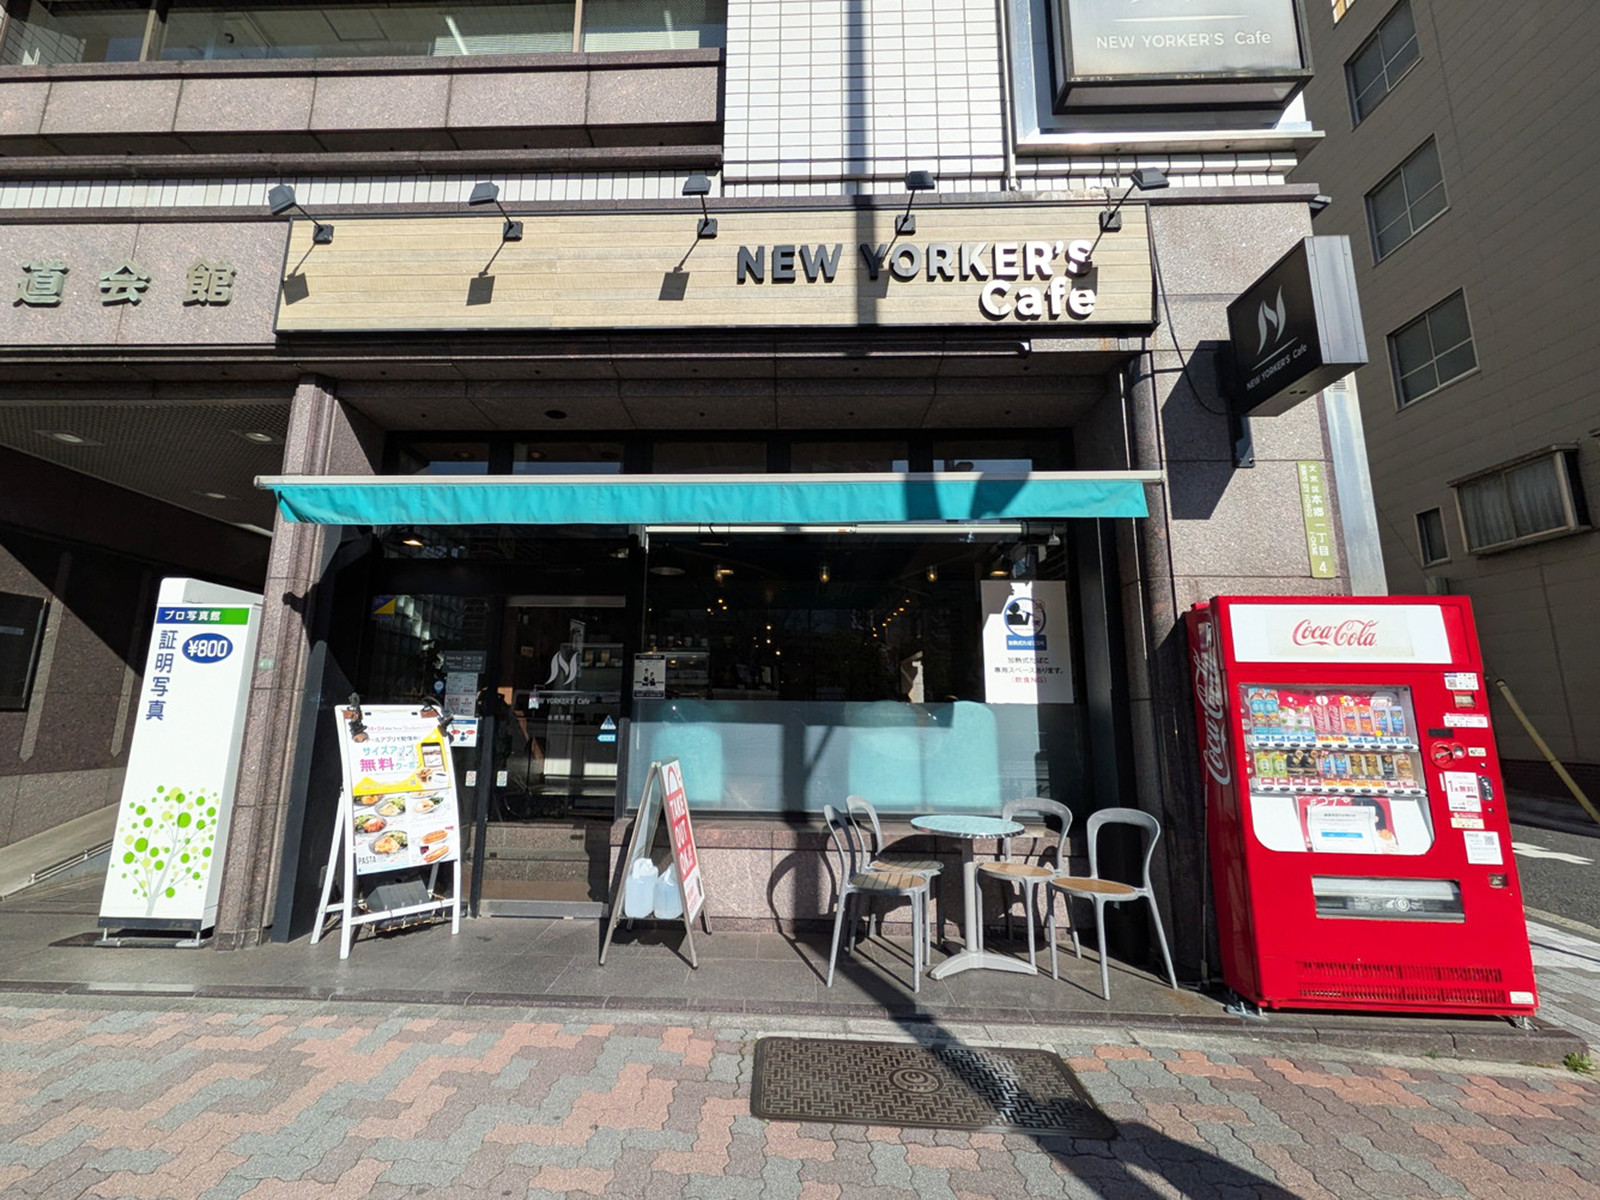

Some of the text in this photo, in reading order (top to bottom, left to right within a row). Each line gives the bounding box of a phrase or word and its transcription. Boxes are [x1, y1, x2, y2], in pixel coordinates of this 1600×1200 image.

[1096, 30, 1272, 49] NEW YORKER'S Cafe
[736, 239, 1094, 285] NEW YORKER'S
[979, 276, 1097, 321] Cafe
[1246, 343, 1308, 391] NEW YORKER'S Cafe
[165, 610, 222, 622] プロ写真館
[1292, 618, 1382, 647] Coca-Cola
[188, 639, 229, 657] ¥800
[1007, 656, 1050, 664] 加熱式たばこ
[146, 629, 179, 721] 証明写真
[1193, 647, 1231, 785] Coca-Cola
[358, 856, 377, 866] PASTA
